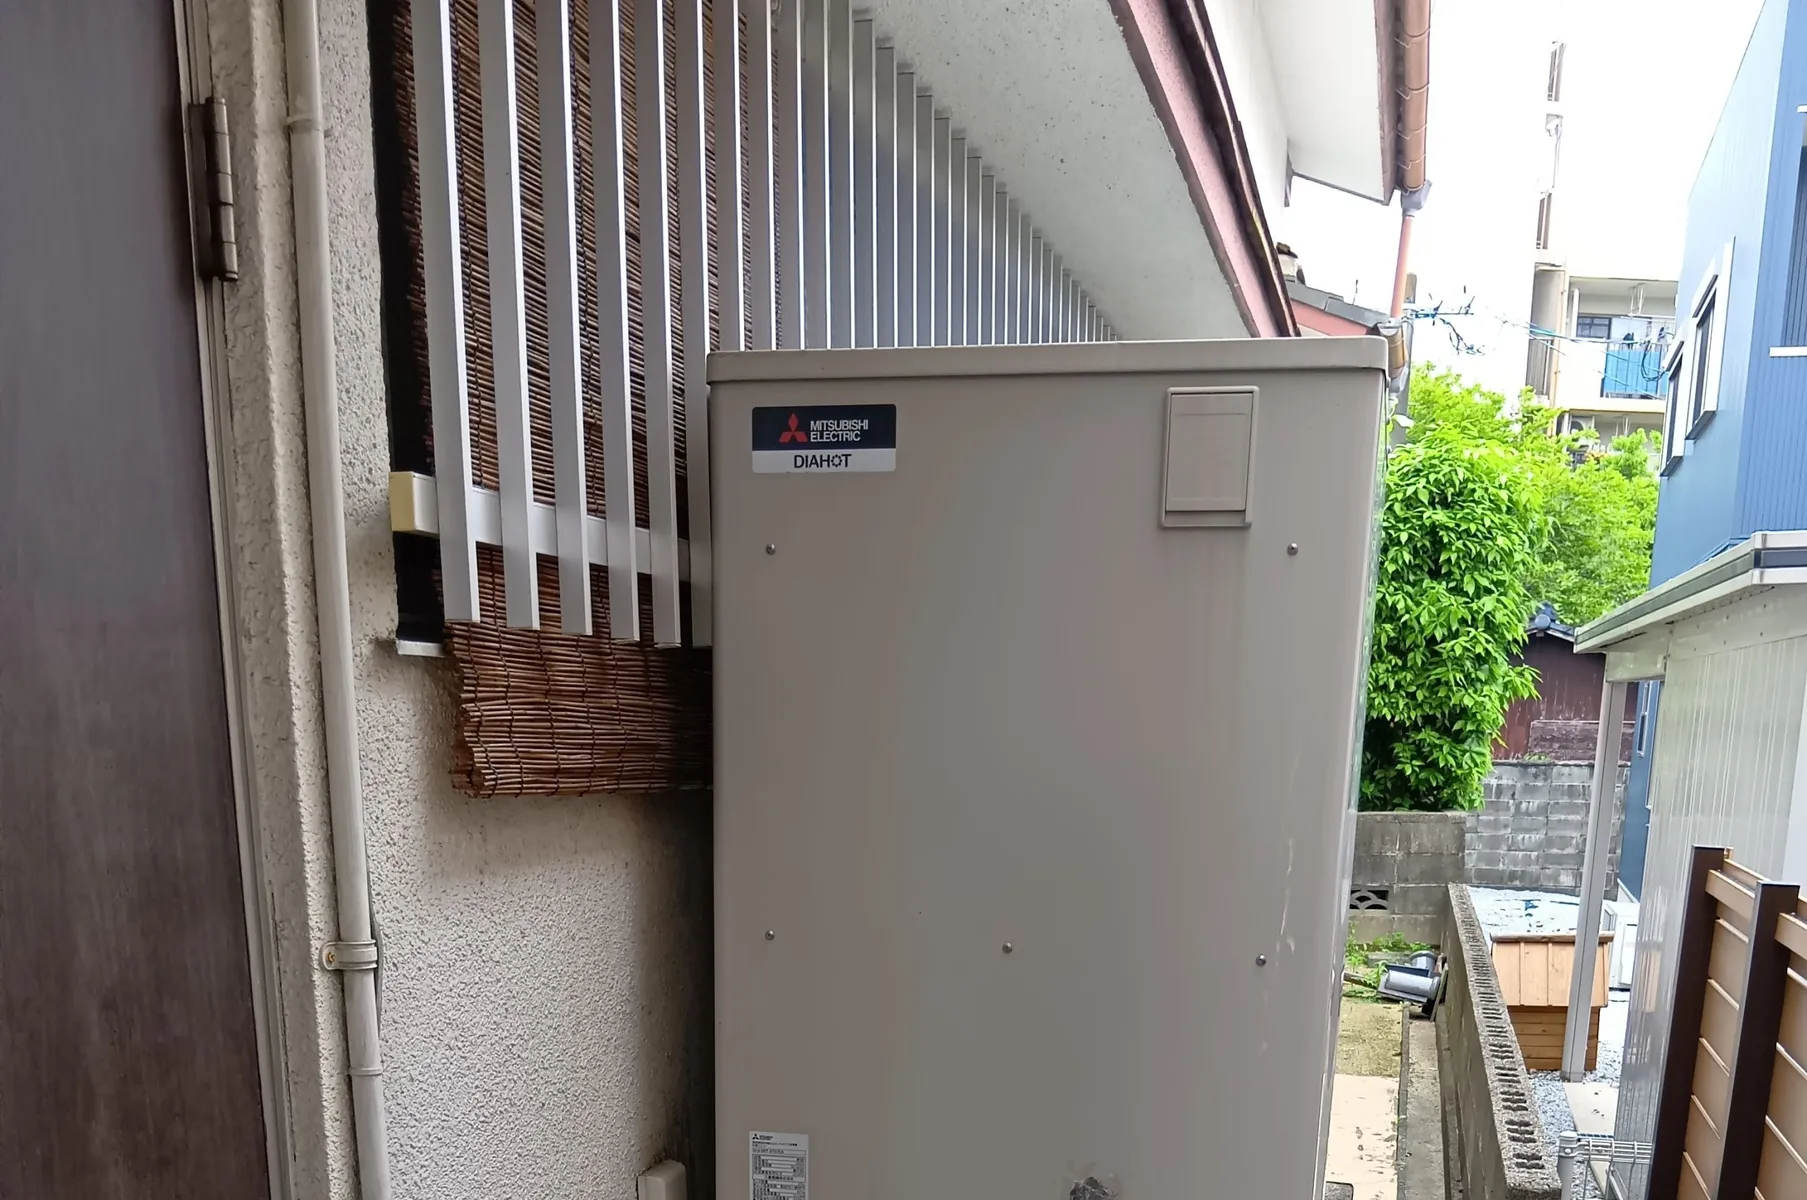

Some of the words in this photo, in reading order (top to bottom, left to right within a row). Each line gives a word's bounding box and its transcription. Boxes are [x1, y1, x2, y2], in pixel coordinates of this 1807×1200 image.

[810, 419, 869, 431] MITSUBISHI
[810, 430, 861, 442] ELECTRIC
[794, 454, 852, 468] DIAHOT
